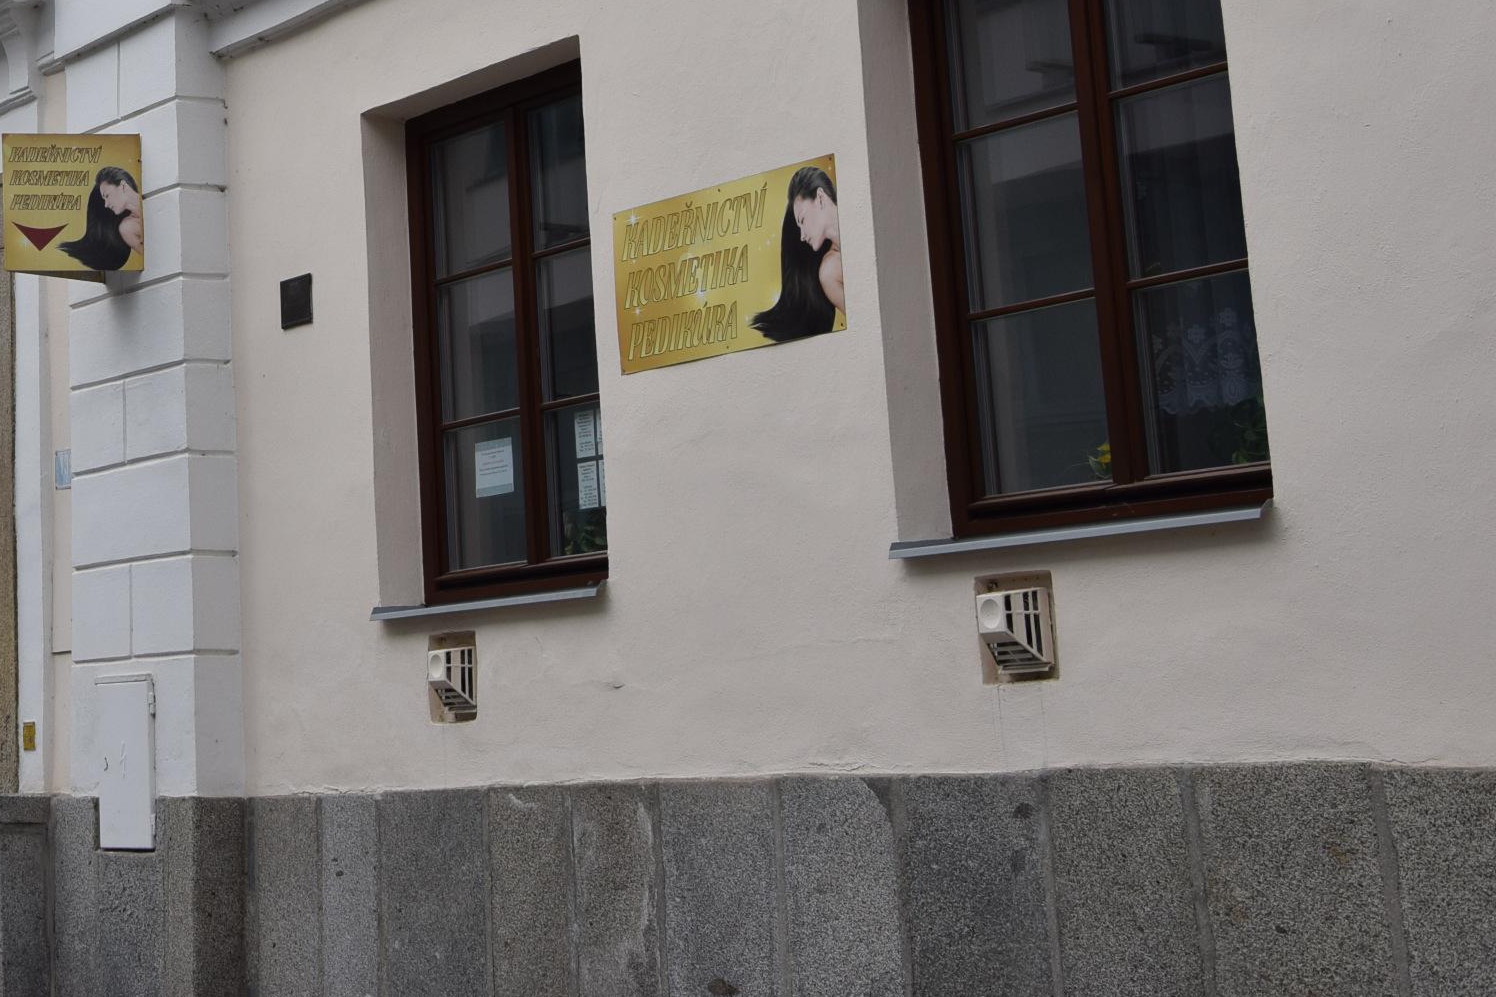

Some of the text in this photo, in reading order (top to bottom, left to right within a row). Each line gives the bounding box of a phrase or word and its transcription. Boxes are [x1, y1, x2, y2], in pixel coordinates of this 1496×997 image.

[9, 144, 103, 163] KADEŘNICTVÍ
[9, 170, 90, 186] KOSMETIKA
[10, 192, 82, 211] PEDIKÚRA
[622, 181, 768, 262] KADEŘNICTVÍ
[624, 243, 749, 310] KOSMETIKA
[628, 300, 738, 361] PEDIKÚRA
